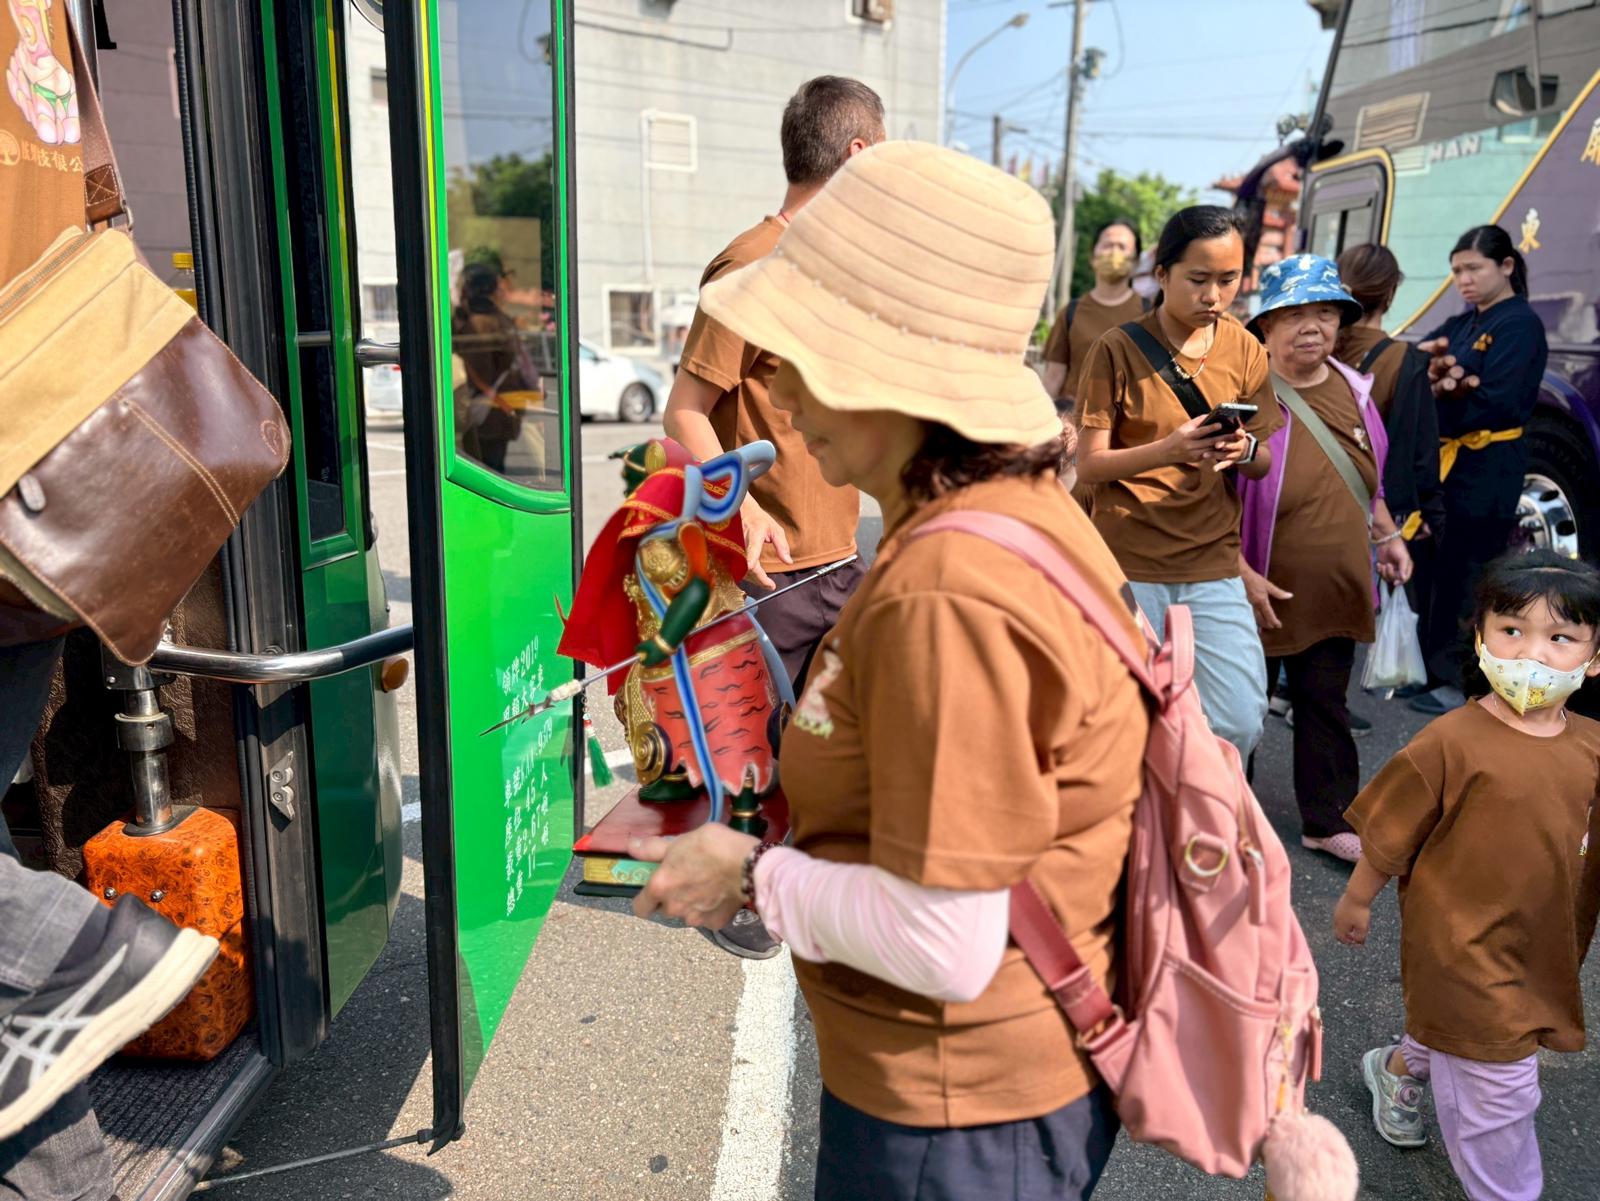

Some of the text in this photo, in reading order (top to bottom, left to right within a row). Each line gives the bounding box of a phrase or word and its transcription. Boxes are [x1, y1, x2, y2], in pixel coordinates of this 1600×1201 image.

[526, 777, 536, 813] 45
[540, 761, 548, 789] 人
[528, 843, 537, 879] 17
